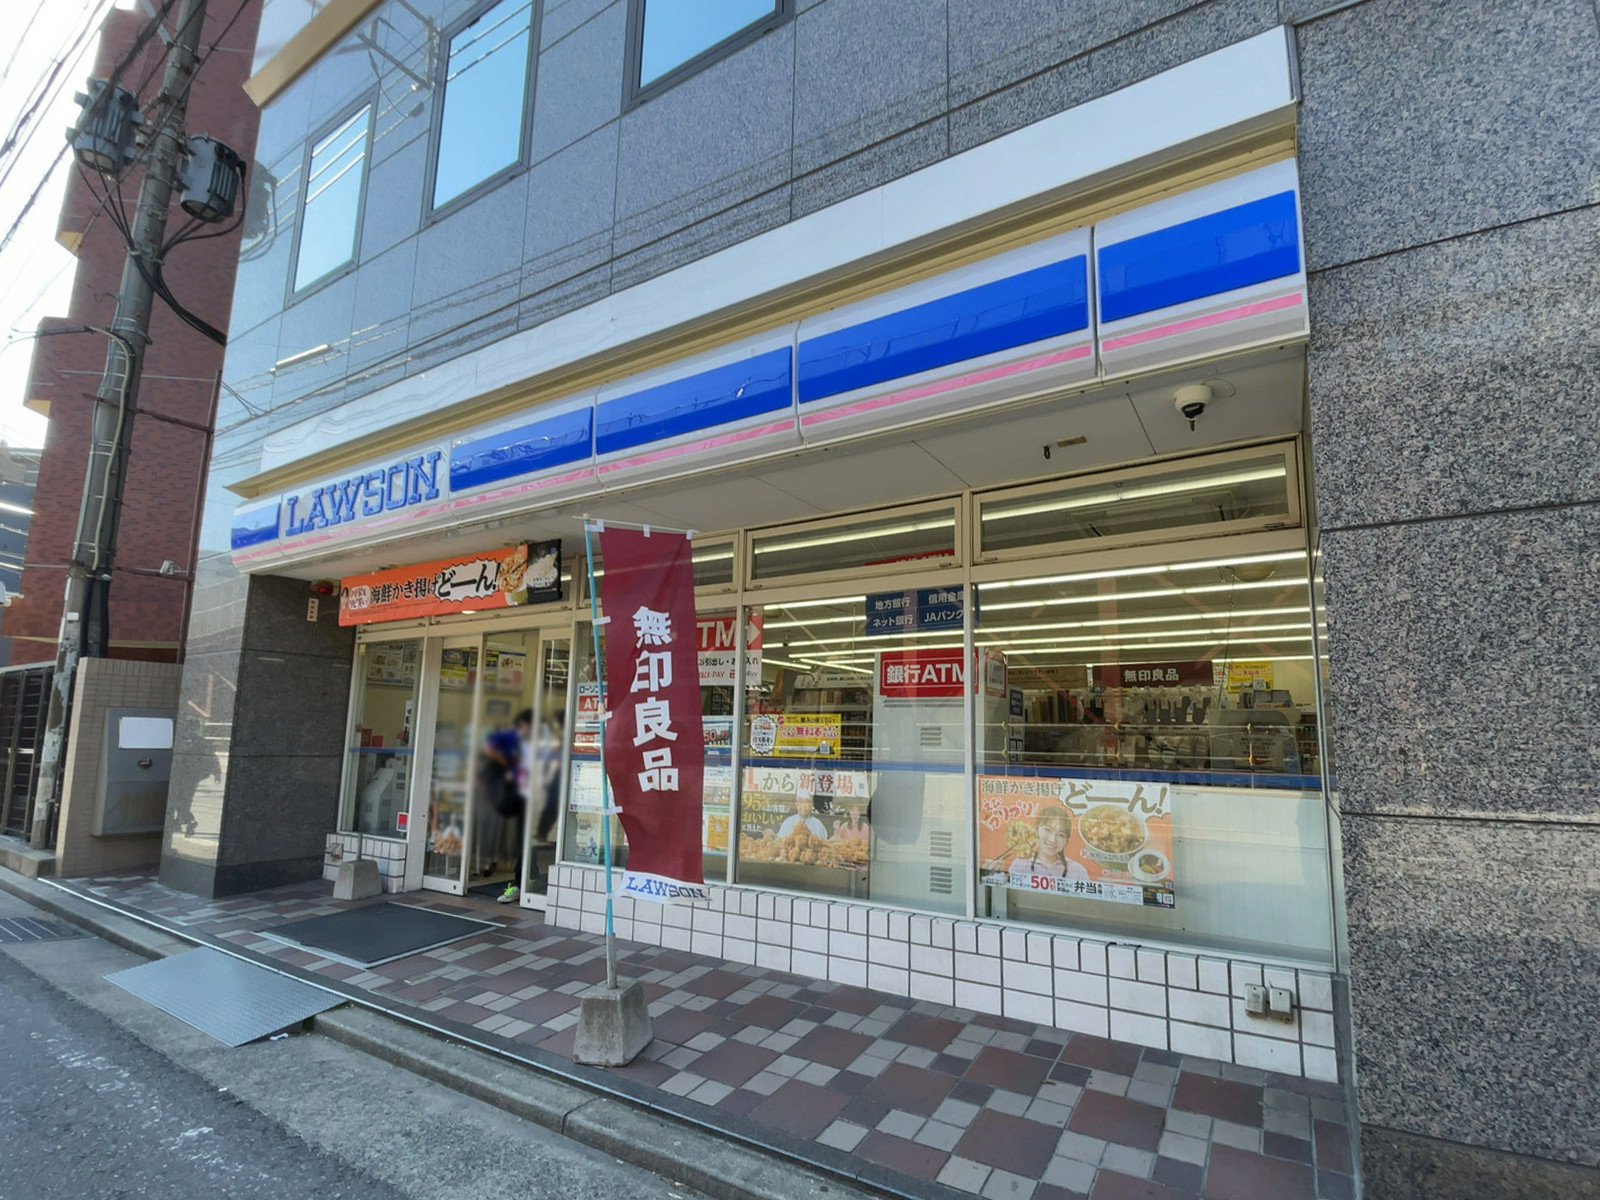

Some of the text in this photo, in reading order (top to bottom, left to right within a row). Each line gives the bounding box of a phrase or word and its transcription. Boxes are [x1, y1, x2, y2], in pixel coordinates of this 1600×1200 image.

[285, 451, 442, 537] LAWSON
[875, 597, 911, 610] 地方銀行
[873, 614, 914, 627] ネット銀行
[696, 620, 737, 648] TM
[1124, 668, 1179, 683] 無印良品
[630, 605, 679, 792] 無印良品
[625, 876, 707, 899] LAWSON
